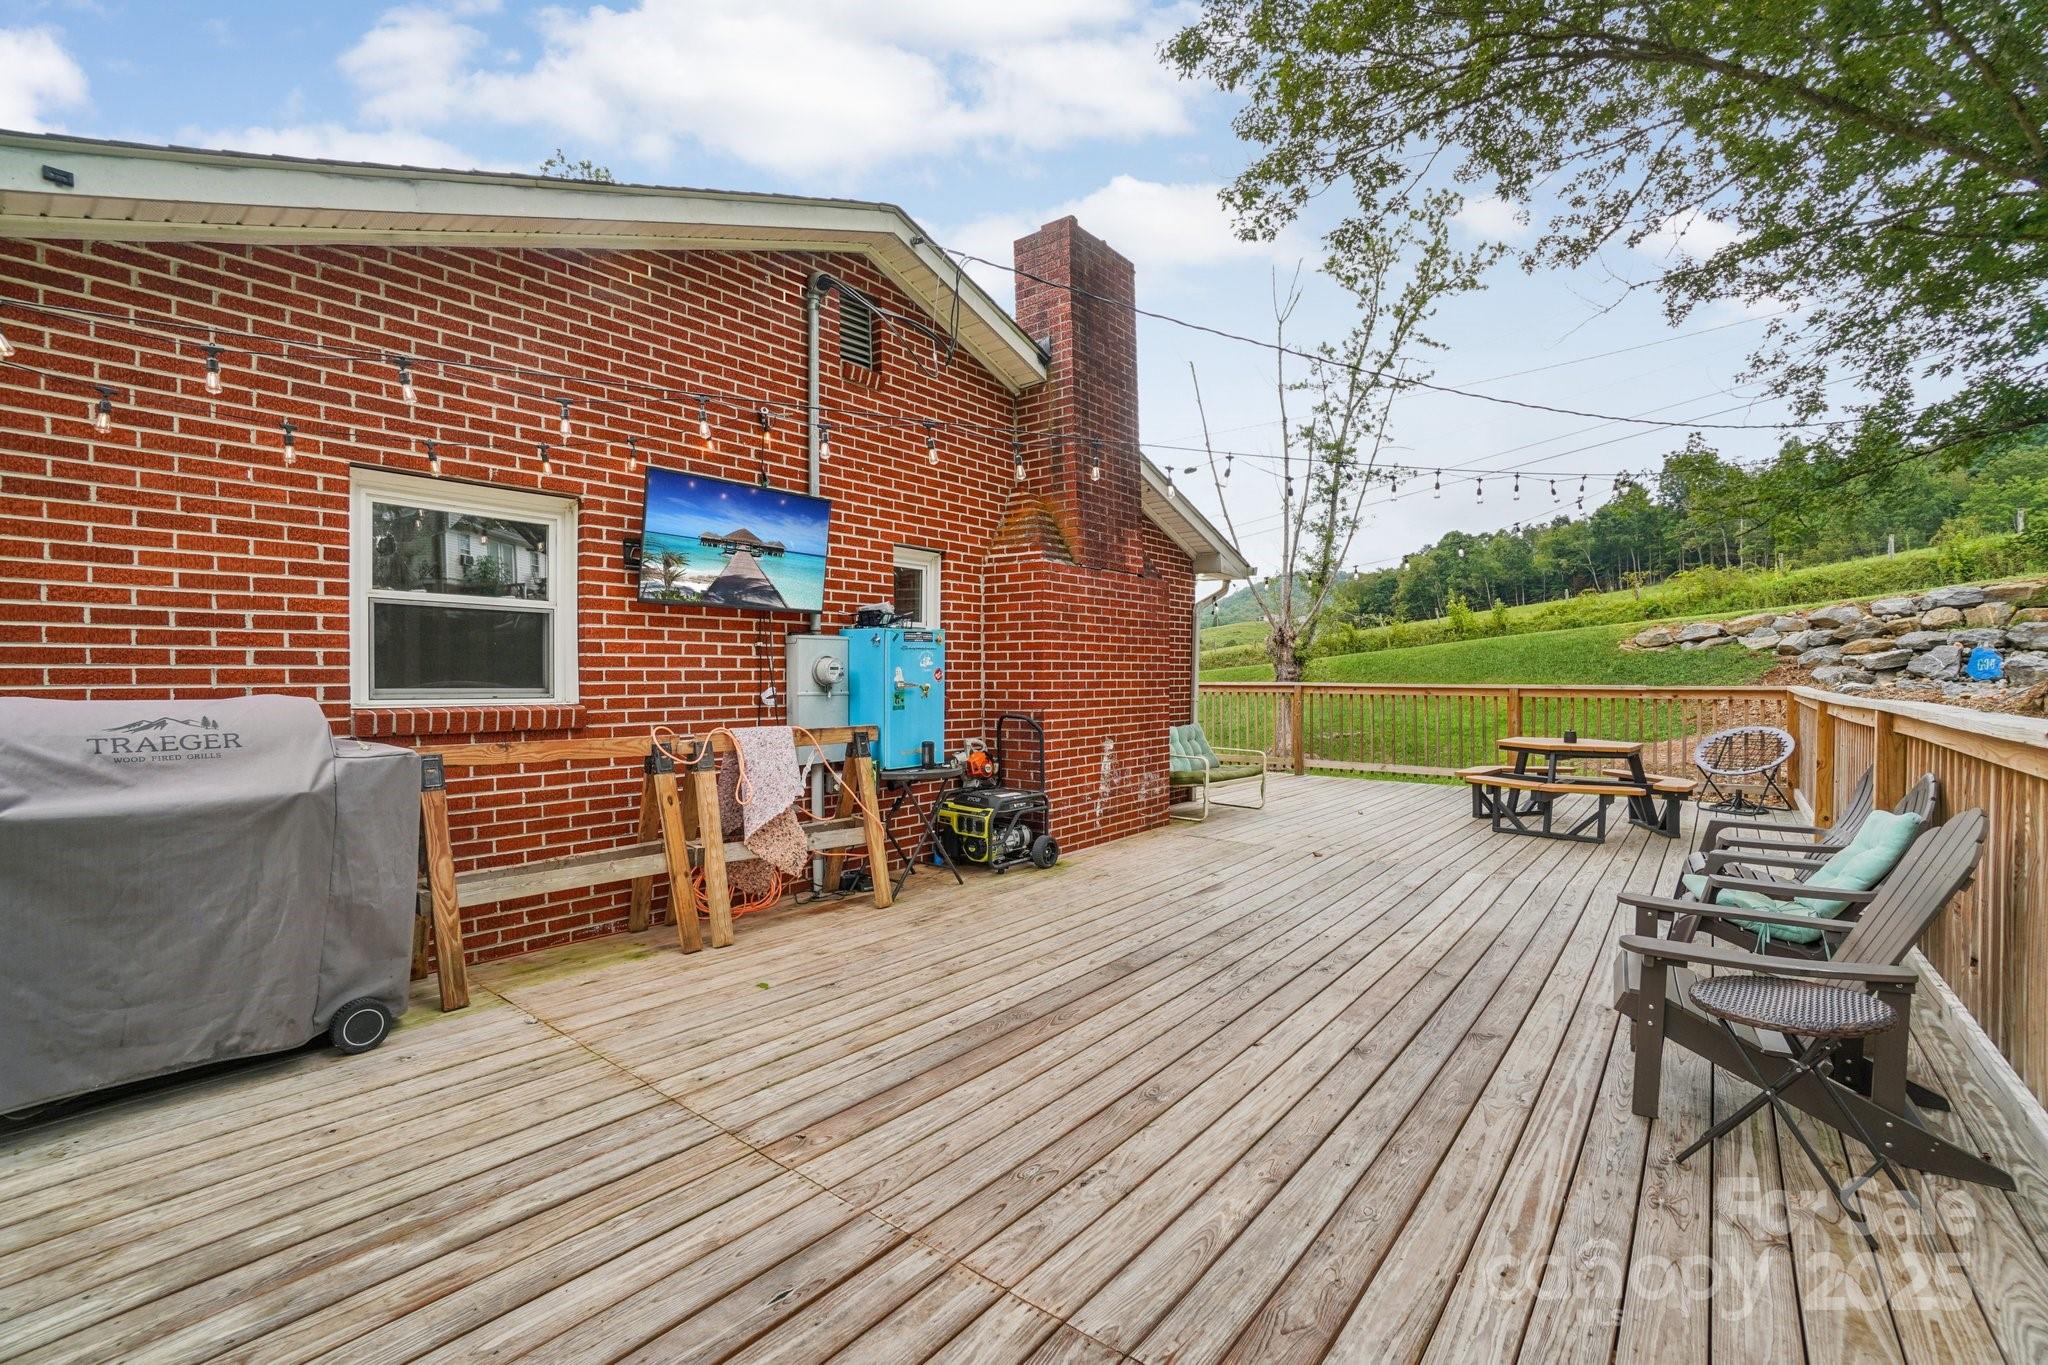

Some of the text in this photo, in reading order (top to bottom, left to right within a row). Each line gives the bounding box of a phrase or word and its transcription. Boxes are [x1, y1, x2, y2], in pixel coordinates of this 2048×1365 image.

[86, 733, 242, 755] TRAEGER
[113, 752, 222, 764] WOOD FIRED GRILLS
